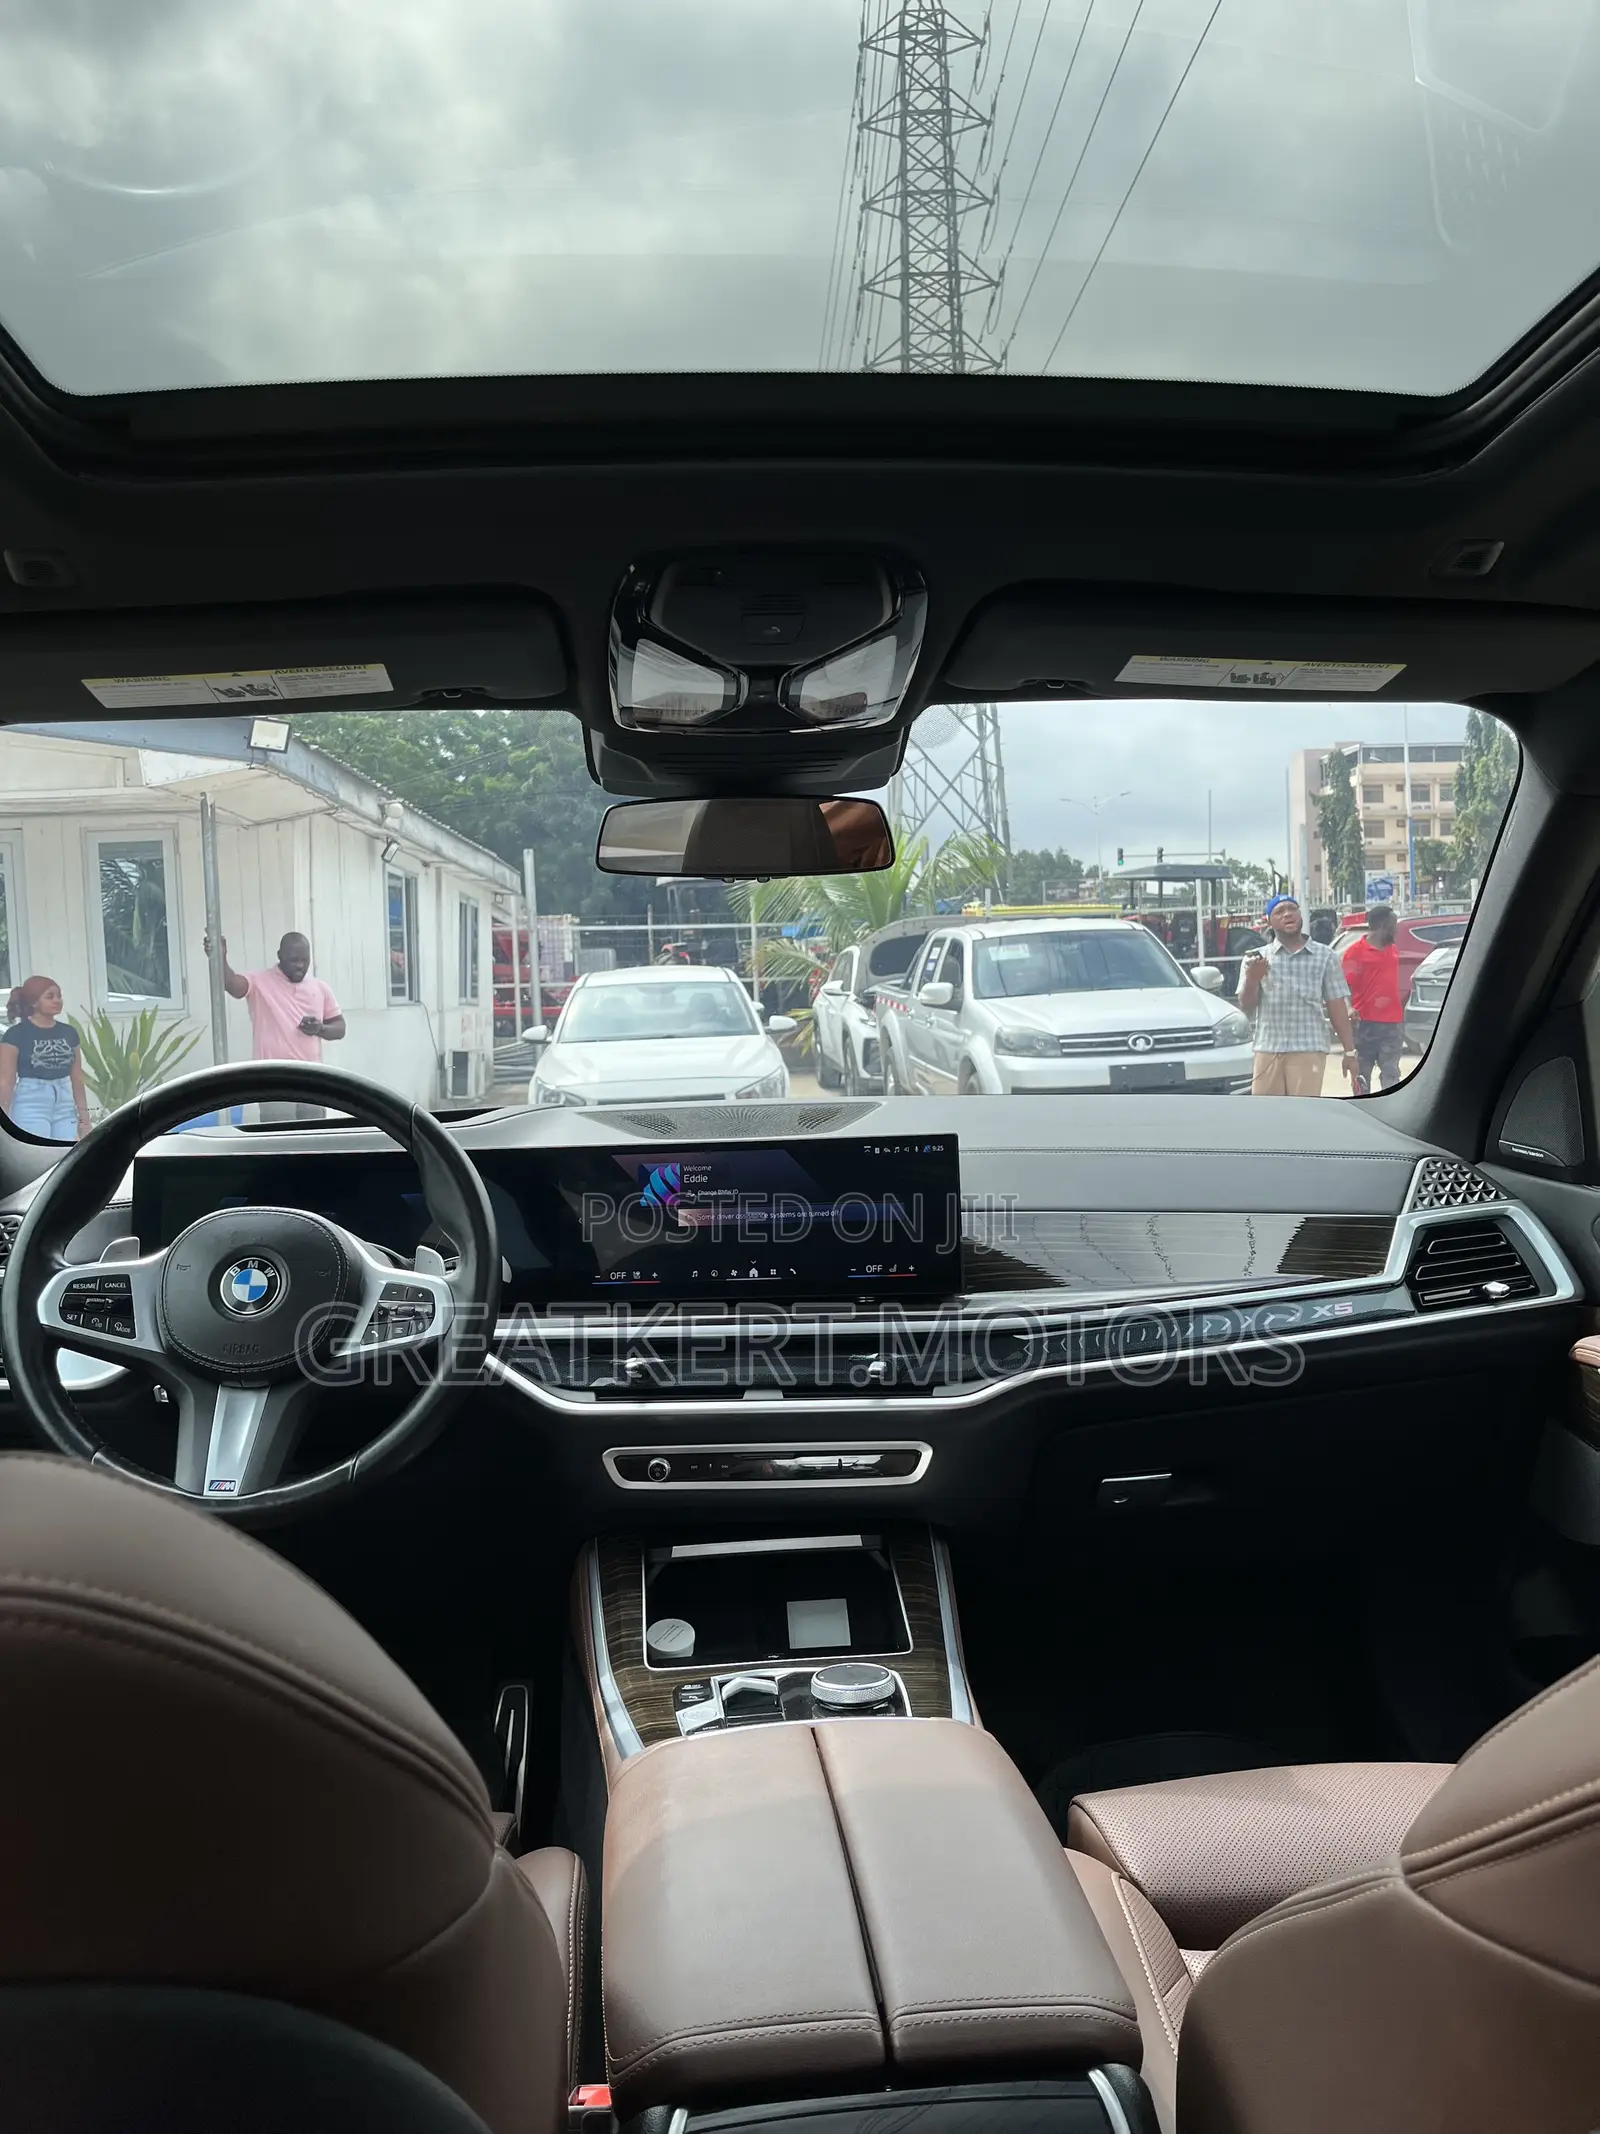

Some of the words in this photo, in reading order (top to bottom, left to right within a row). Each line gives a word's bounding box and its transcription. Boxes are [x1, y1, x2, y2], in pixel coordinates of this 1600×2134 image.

[274, 665, 368, 675] AVERTISSEMENT
[683, 1174, 709, 1183] Eddie
[697, 1213, 715, 1221] Some
[230, 1260, 275, 1278] BMW
[866, 1264, 883, 1273] OFF
[610, 1272, 627, 1280] OFF
[1311, 1302, 1352, 1319] X5
